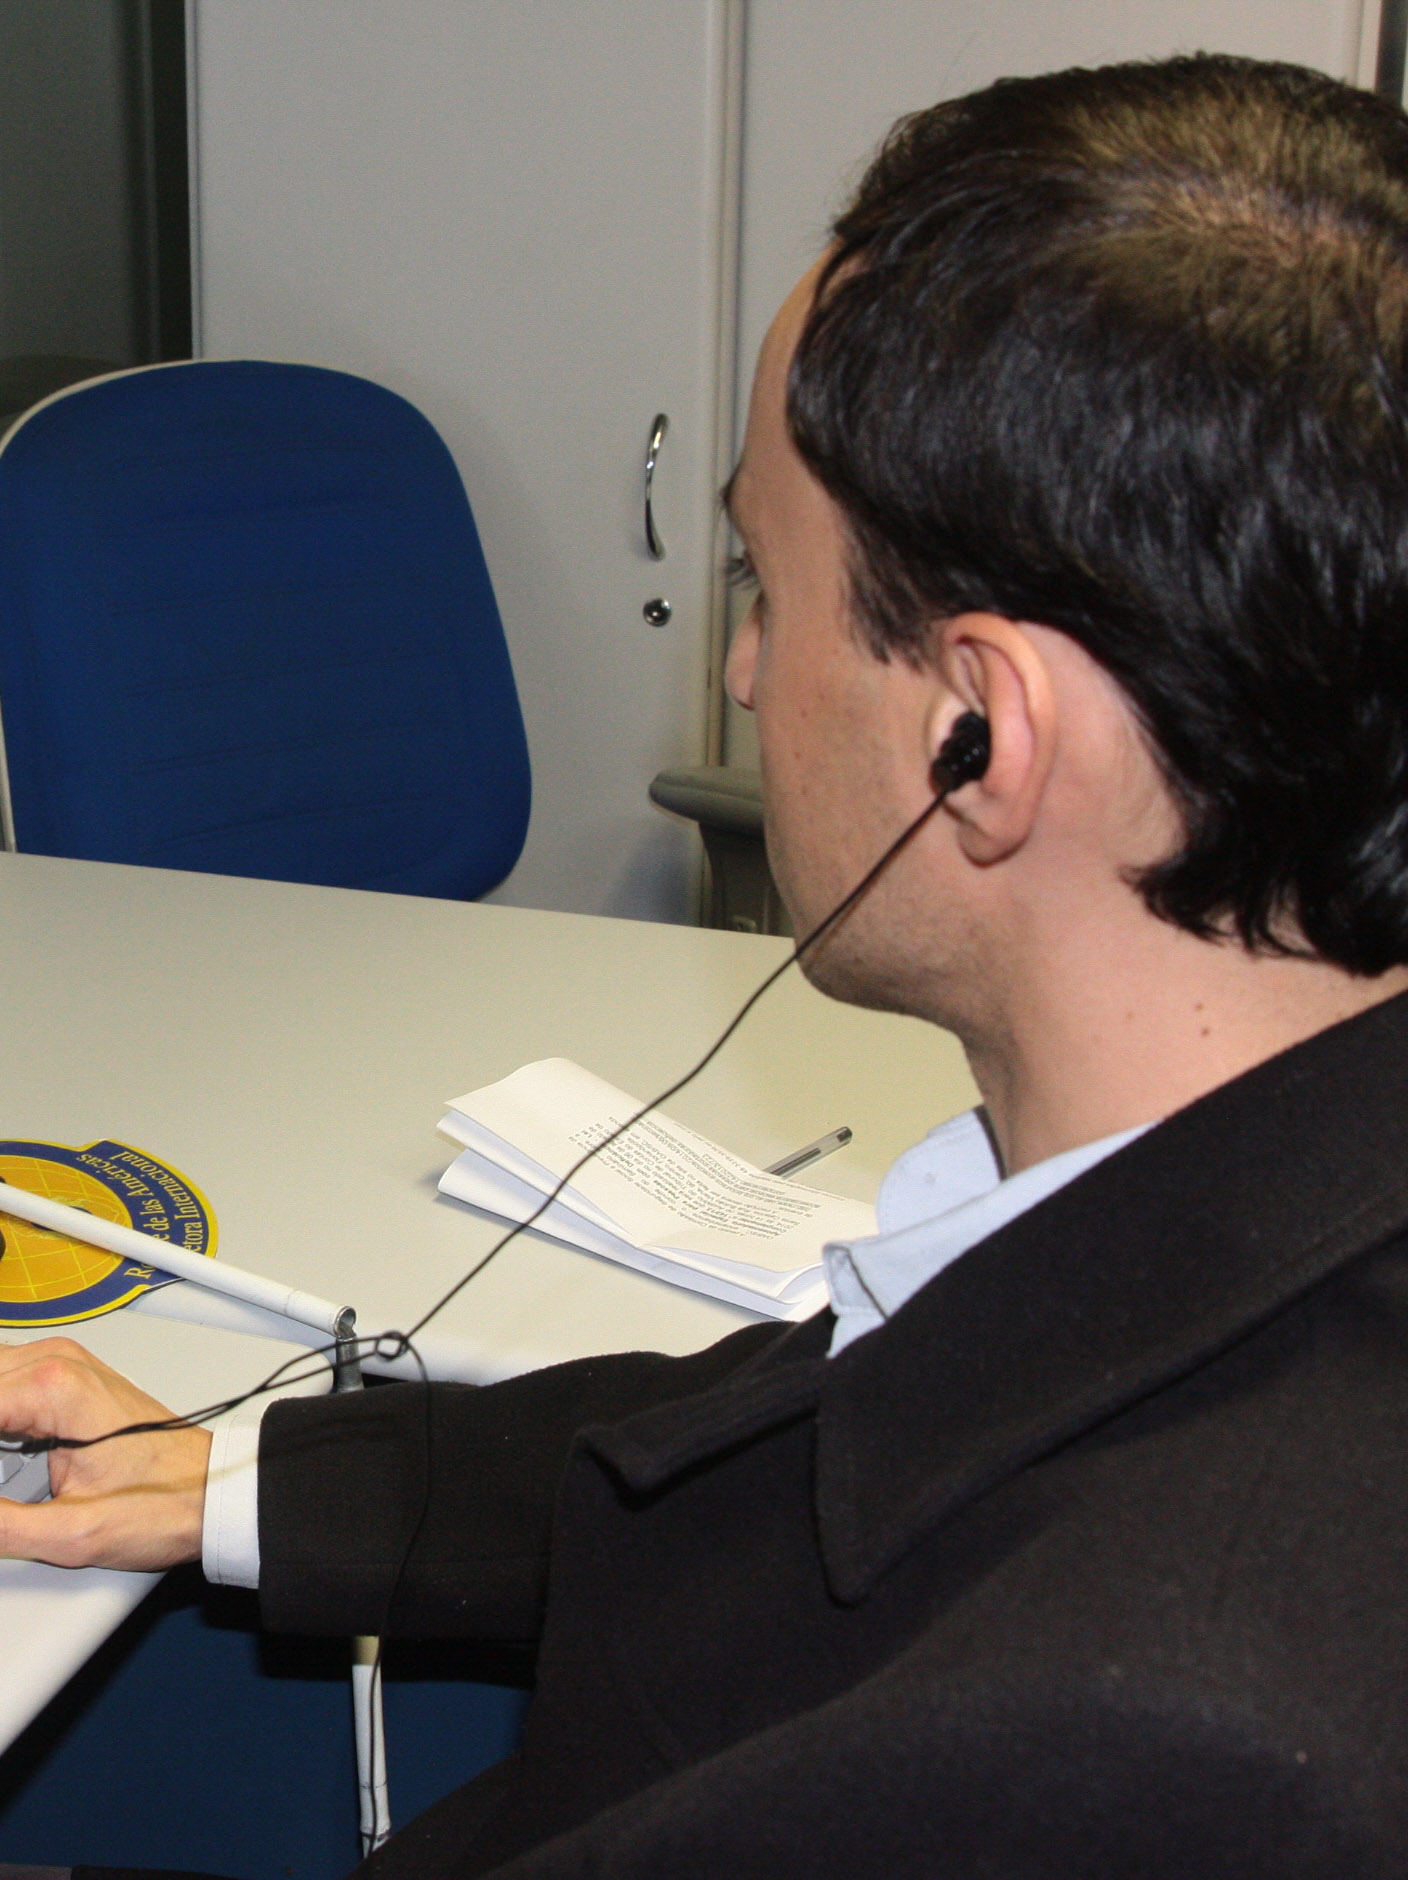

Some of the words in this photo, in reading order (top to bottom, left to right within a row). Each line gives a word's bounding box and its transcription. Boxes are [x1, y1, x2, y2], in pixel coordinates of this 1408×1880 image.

[76, 1152, 155, 1199] Américas
[110, 1150, 201, 1223] Internacional
[138, 1196, 161, 1216] las
[144, 1213, 170, 1233] de
